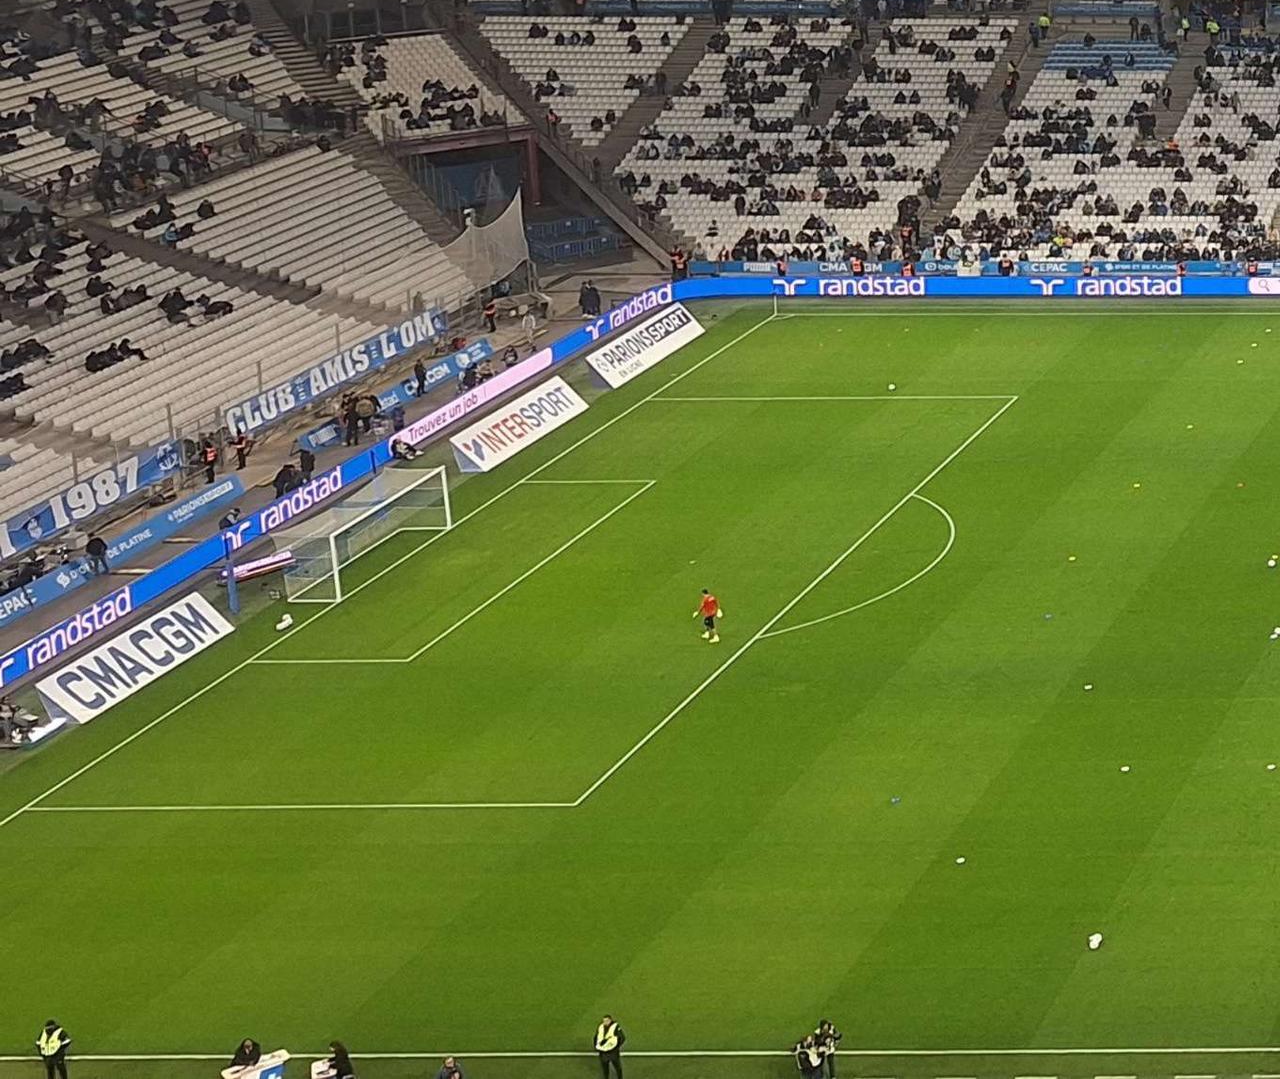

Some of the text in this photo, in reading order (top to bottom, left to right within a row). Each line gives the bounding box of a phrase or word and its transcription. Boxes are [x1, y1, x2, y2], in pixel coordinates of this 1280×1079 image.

[819, 262, 847, 272] CMA
[819, 276, 925, 296] randstad
[1030, 263, 1067, 272] CEPAC
[1076, 276, 1182, 295] randstad
[609, 283, 672, 330] randstad
[224, 383, 296, 438] CLUB
[309, 344, 370, 396] AMIS
[378, 311, 435, 359] L'OM
[408, 393, 479, 442] Trouvez un job
[477, 386, 575, 454] INTERSPORT
[49, 455, 139, 529] 1987
[260, 465, 342, 532] randstad
[27, 585, 132, 669] randstad
[56, 602, 220, 710] CMA CGM
